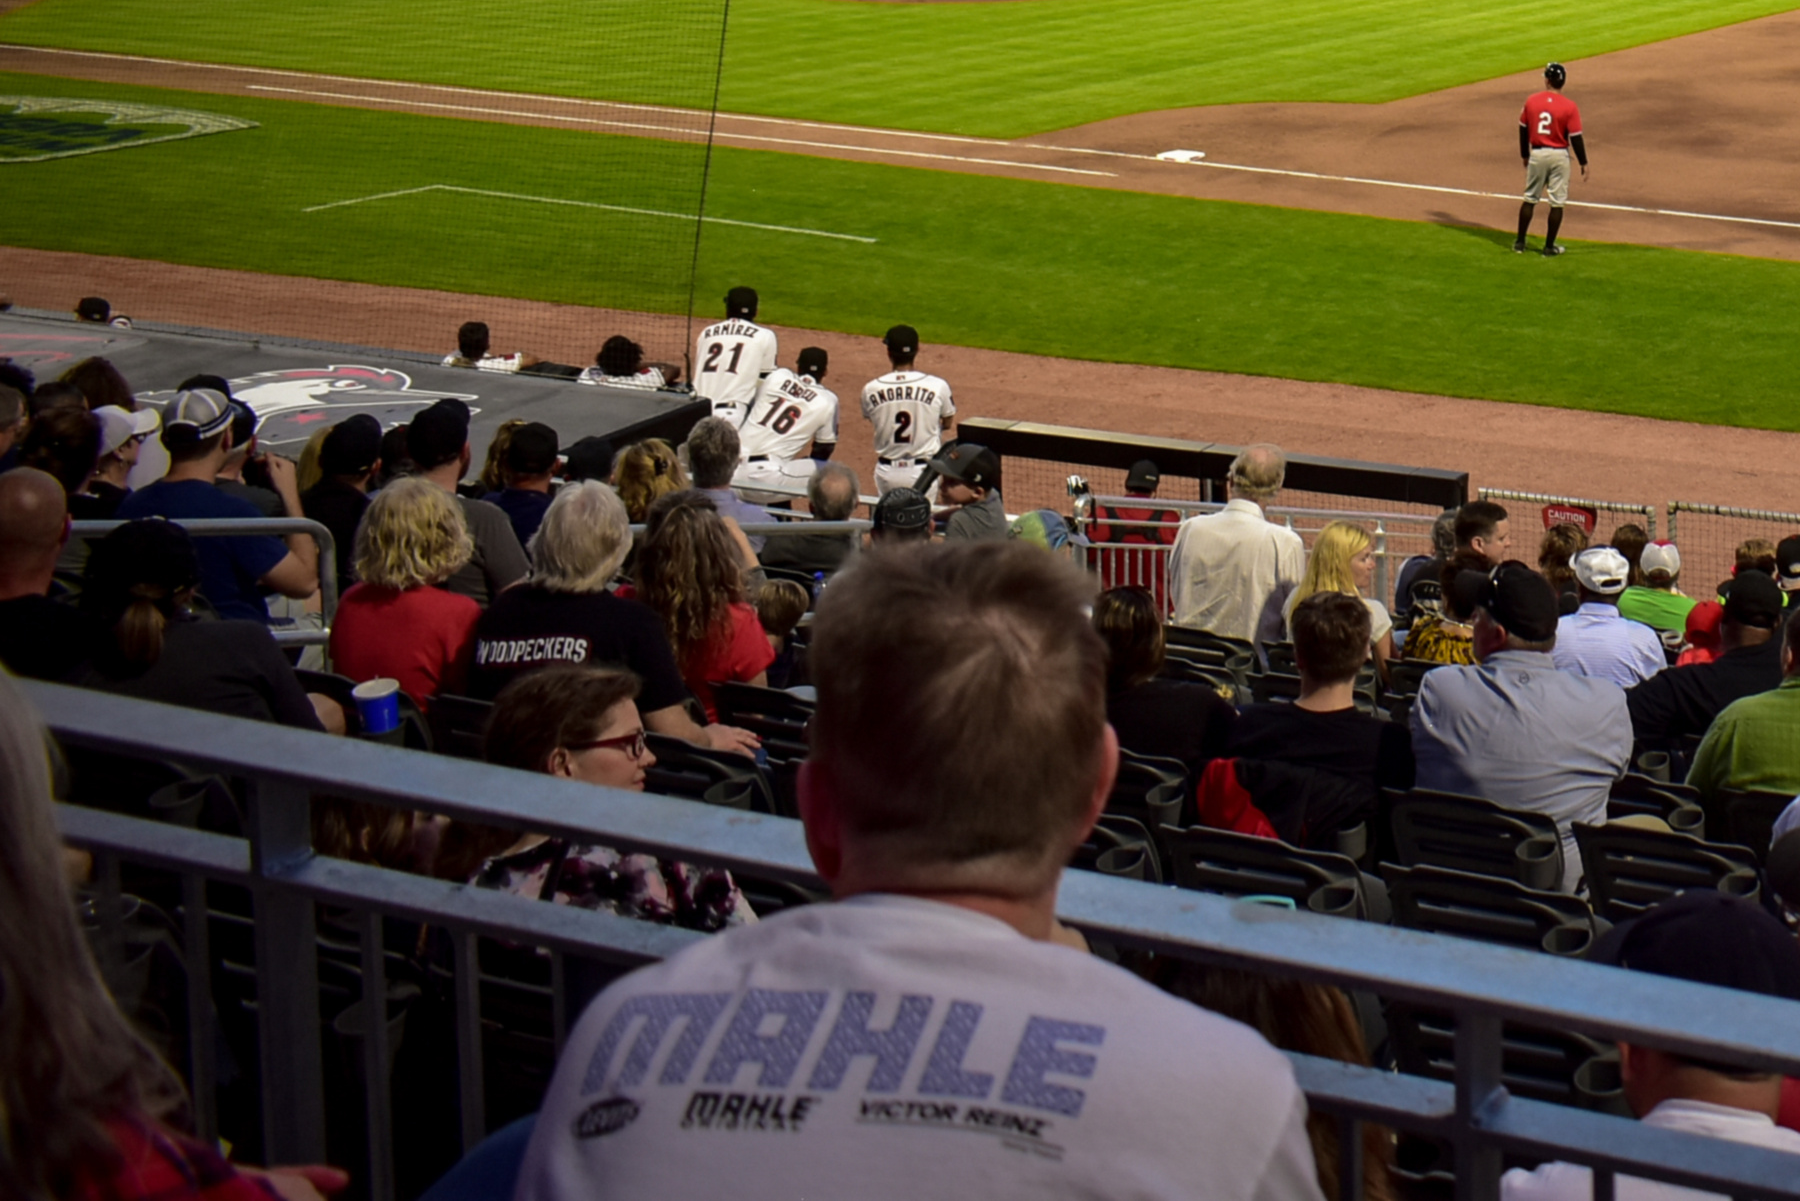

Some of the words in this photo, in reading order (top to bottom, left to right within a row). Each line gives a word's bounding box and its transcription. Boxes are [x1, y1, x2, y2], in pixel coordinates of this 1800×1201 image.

[1537, 111, 1552, 135] 2
[705, 323, 759, 339] RAMIREZ
[702, 342, 745, 375] 21
[757, 397, 802, 435] 16
[894, 410, 912, 444] 2
[1548, 509, 1586, 523] CAUTION
[476, 637, 588, 664] WOODPECKERS
[579, 988, 1107, 1119] MAHLE
[685, 1092, 811, 1121] MAHLE
[860, 1100, 958, 1120] VICTOR
[964, 1105, 1047, 1138] REINZ
